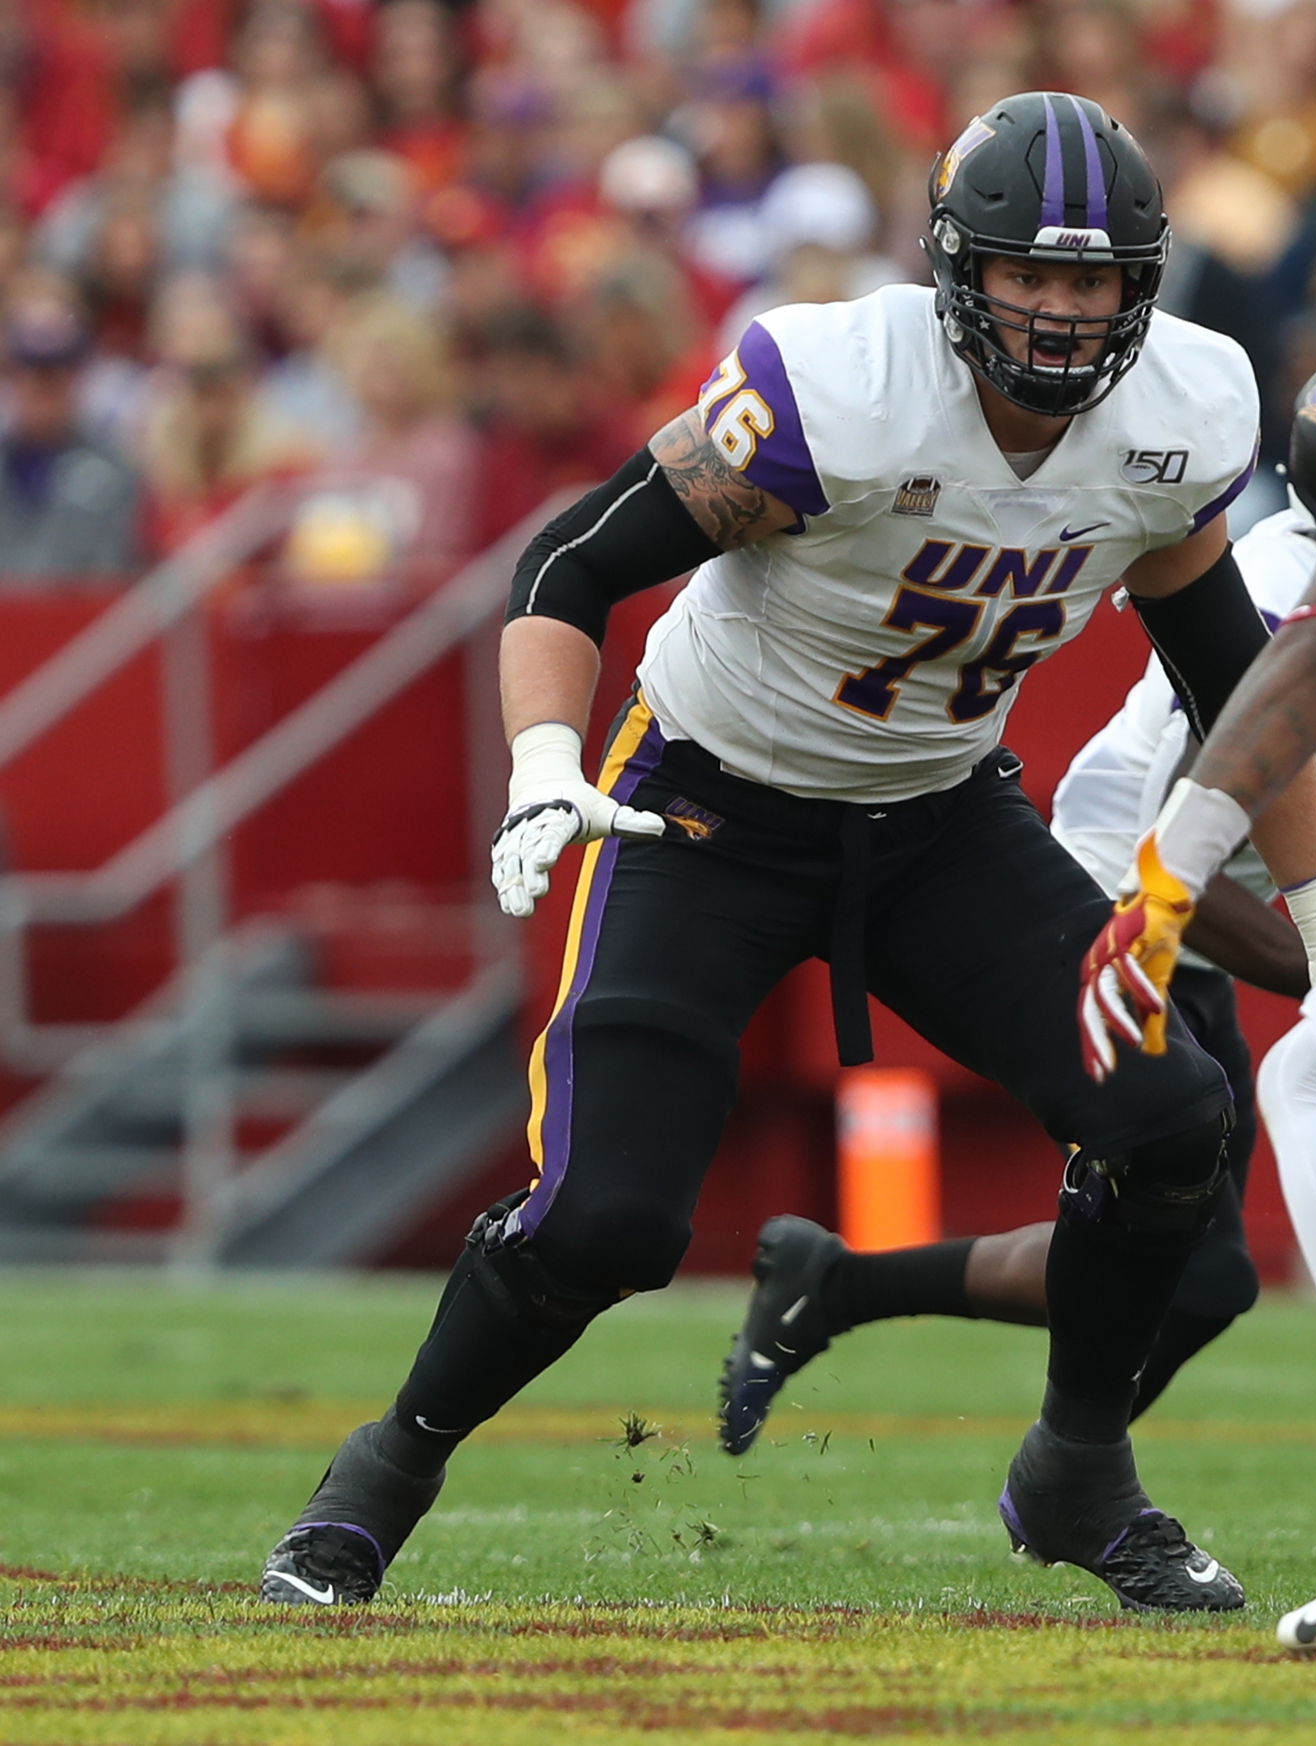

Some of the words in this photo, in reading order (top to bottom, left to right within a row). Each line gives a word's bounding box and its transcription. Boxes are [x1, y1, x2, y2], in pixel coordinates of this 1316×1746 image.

[1056, 232, 1093, 247] UNI
[698, 346, 776, 471] 76
[1119, 449, 1190, 485] 150
[894, 487, 939, 508] VALLEY
[901, 538, 1096, 599] UNI
[831, 583, 1067, 725] 76
[665, 796, 726, 831] UNI
